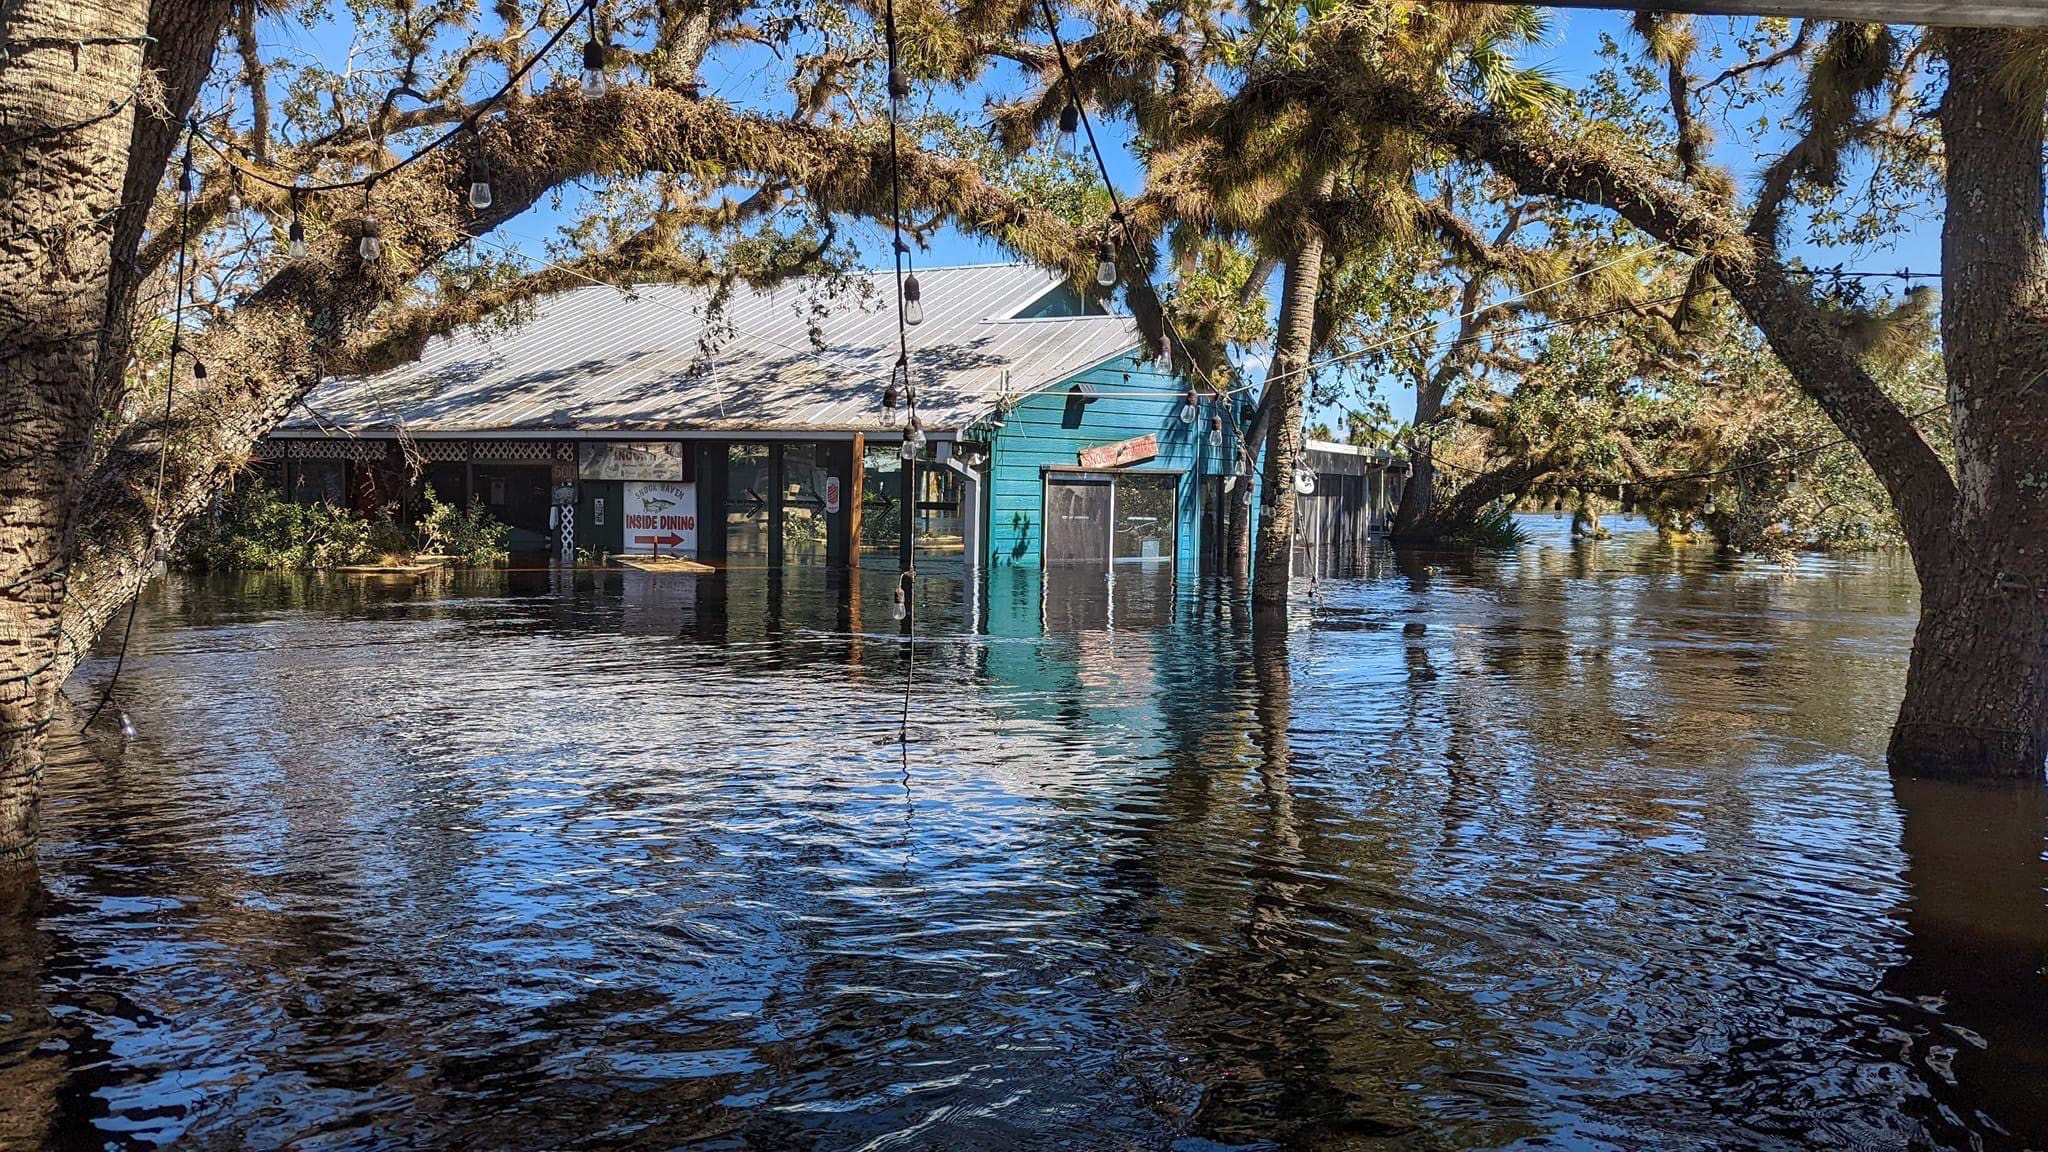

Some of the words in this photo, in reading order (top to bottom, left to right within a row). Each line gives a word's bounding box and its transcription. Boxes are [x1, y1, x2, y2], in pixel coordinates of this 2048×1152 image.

[635, 482, 658, 500] SNOOK
[661, 483, 685, 500] HAVEN
[626, 514, 658, 529] INSIDE
[660, 515, 695, 531] DINING
